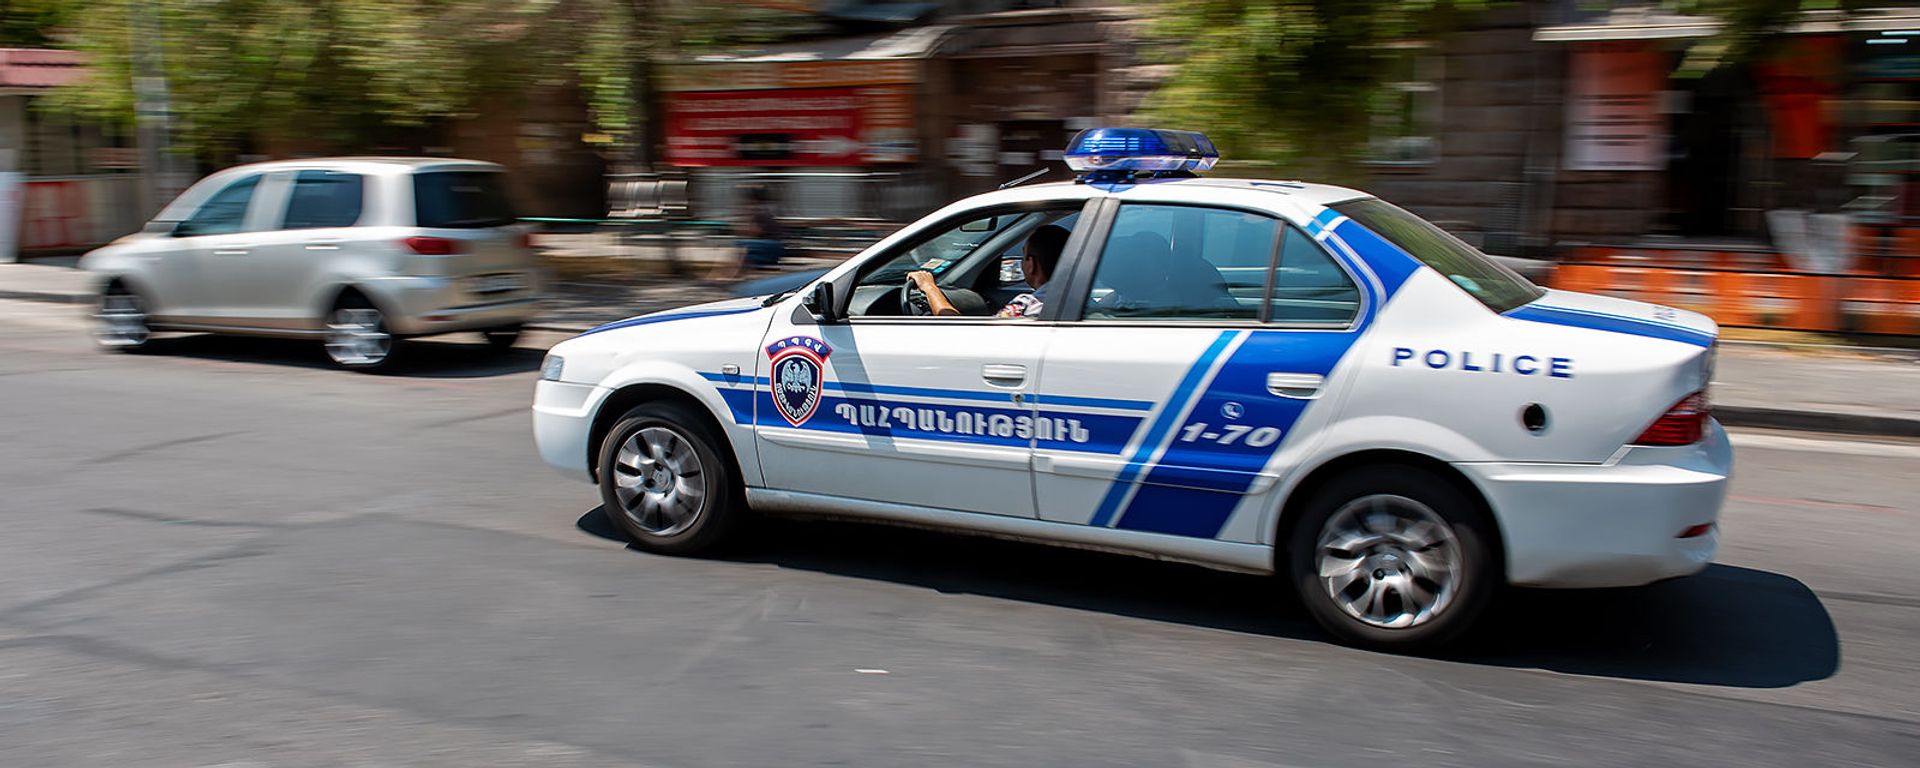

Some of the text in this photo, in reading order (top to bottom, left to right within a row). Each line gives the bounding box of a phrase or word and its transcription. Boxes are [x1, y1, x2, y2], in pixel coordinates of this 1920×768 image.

[1391, 346, 1576, 379] POLICE
[835, 403, 1089, 442] ՊԱՀՊԱՆՈՒԹՅՈՒՆ
[1180, 422, 1282, 448] 1-70
